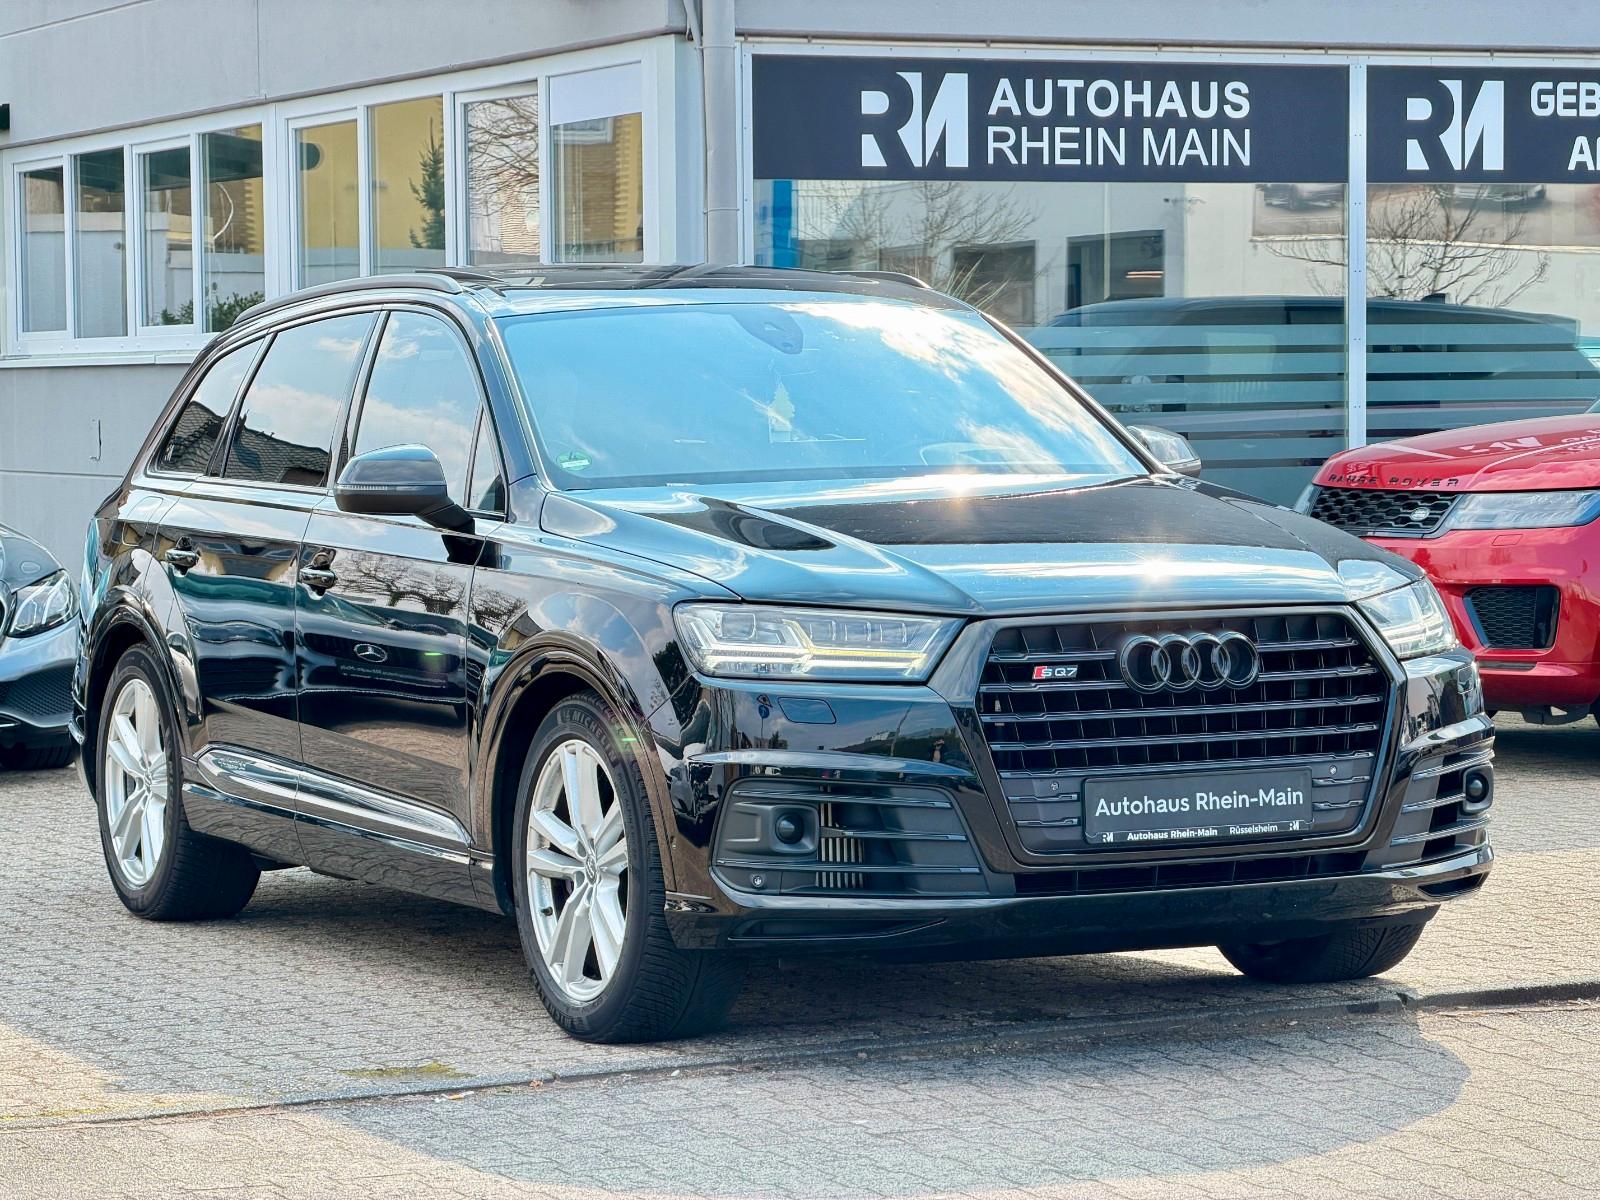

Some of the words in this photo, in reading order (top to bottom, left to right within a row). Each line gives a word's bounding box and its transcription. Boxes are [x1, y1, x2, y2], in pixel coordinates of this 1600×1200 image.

[988, 78, 1250, 118] AUTOHAUS
[1531, 82, 1600, 116] GEB
[988, 126, 1126, 165] RHEIN
[1143, 127, 1250, 166] MAIN
[1568, 136, 1600, 170] A
[1328, 473, 1377, 484] RANGE
[1389, 477, 1459, 487] ROVER
[571, 710, 619, 763] MICHELIN
[1095, 795, 1190, 817] Autohaus
[1196, 788, 1304, 812] Rhein-Main
[1127, 831, 1169, 841] Autohaus
[1171, 828, 1218, 839] Rhein-Main
[1229, 823, 1278, 835] Rüsselsheim
